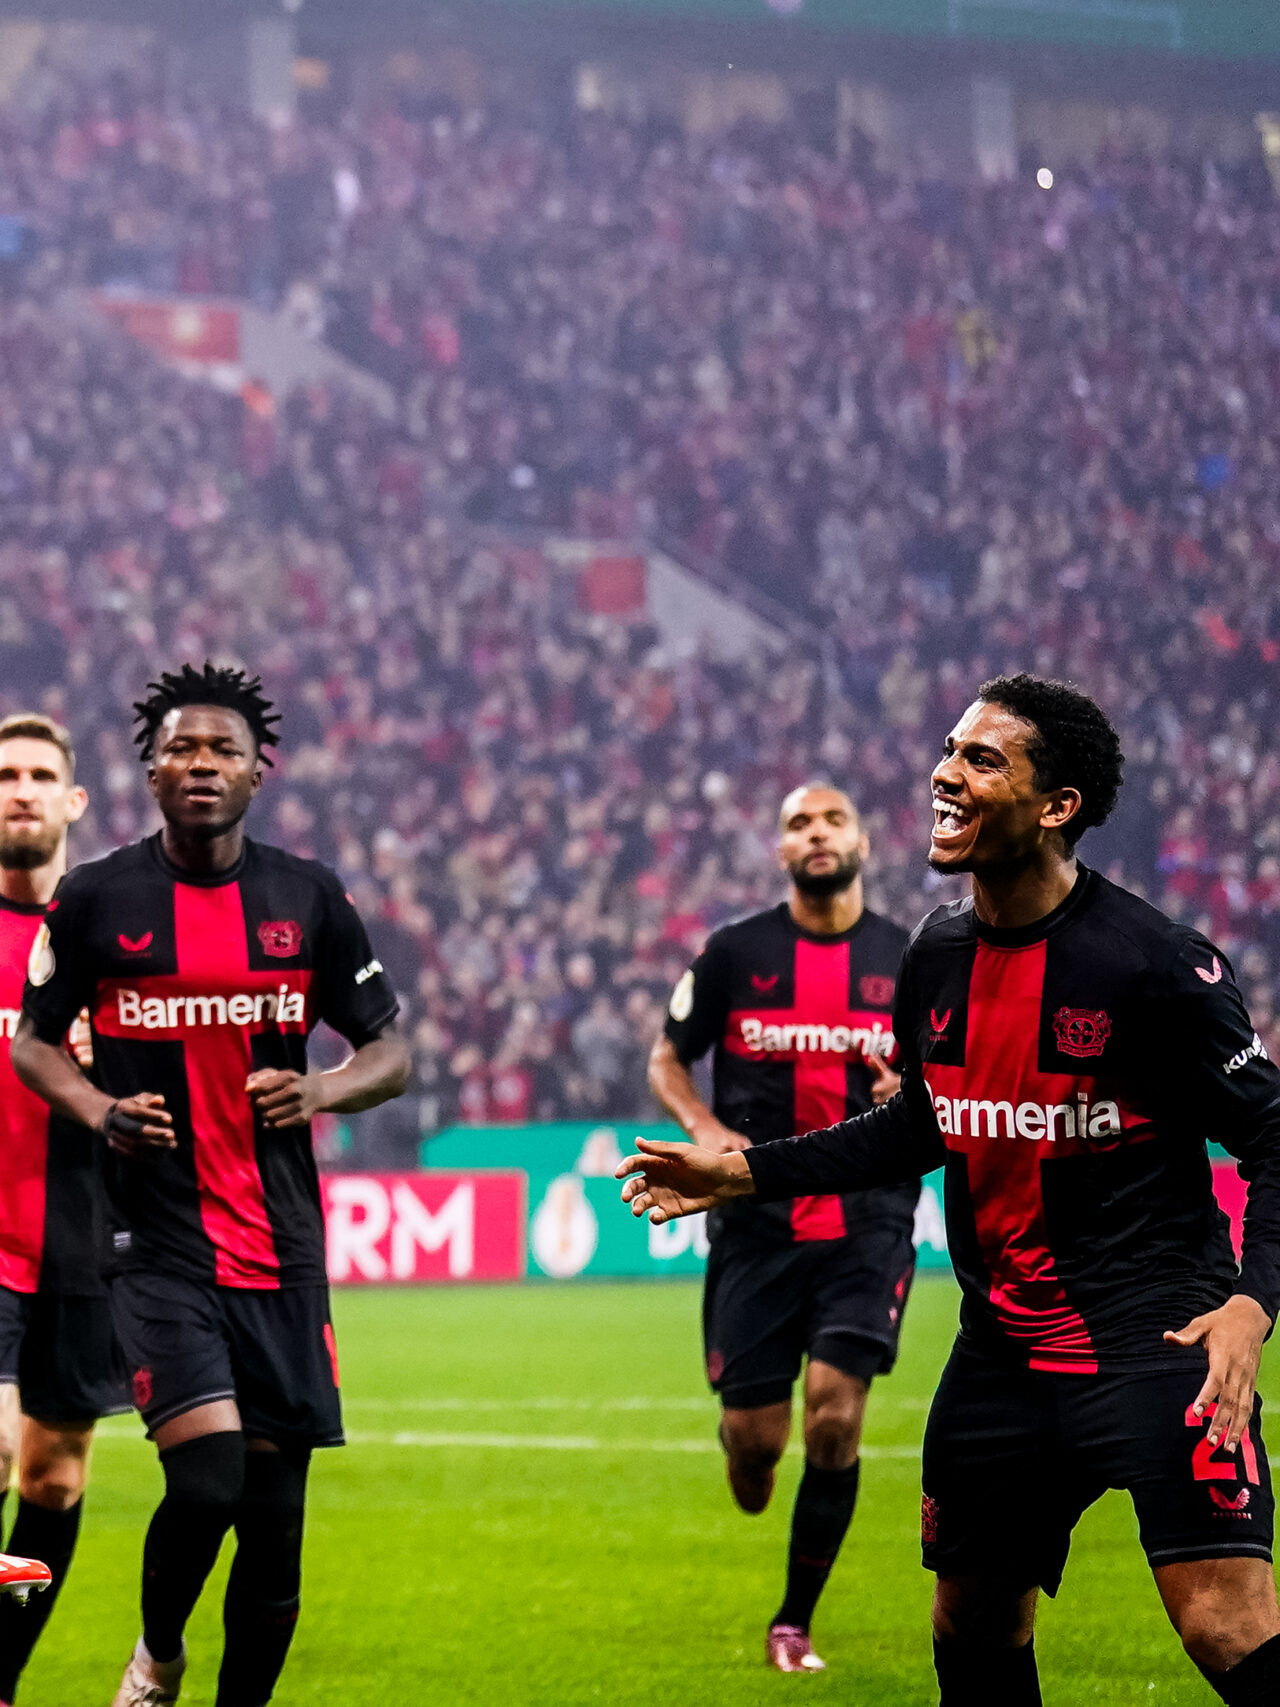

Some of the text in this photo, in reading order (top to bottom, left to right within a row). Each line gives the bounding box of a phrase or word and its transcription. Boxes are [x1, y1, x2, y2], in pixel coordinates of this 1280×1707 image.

[117, 983, 305, 1029] Barmenia
[740, 1017, 897, 1057] Barmenia
[1184, 1401, 1261, 1486] 21
